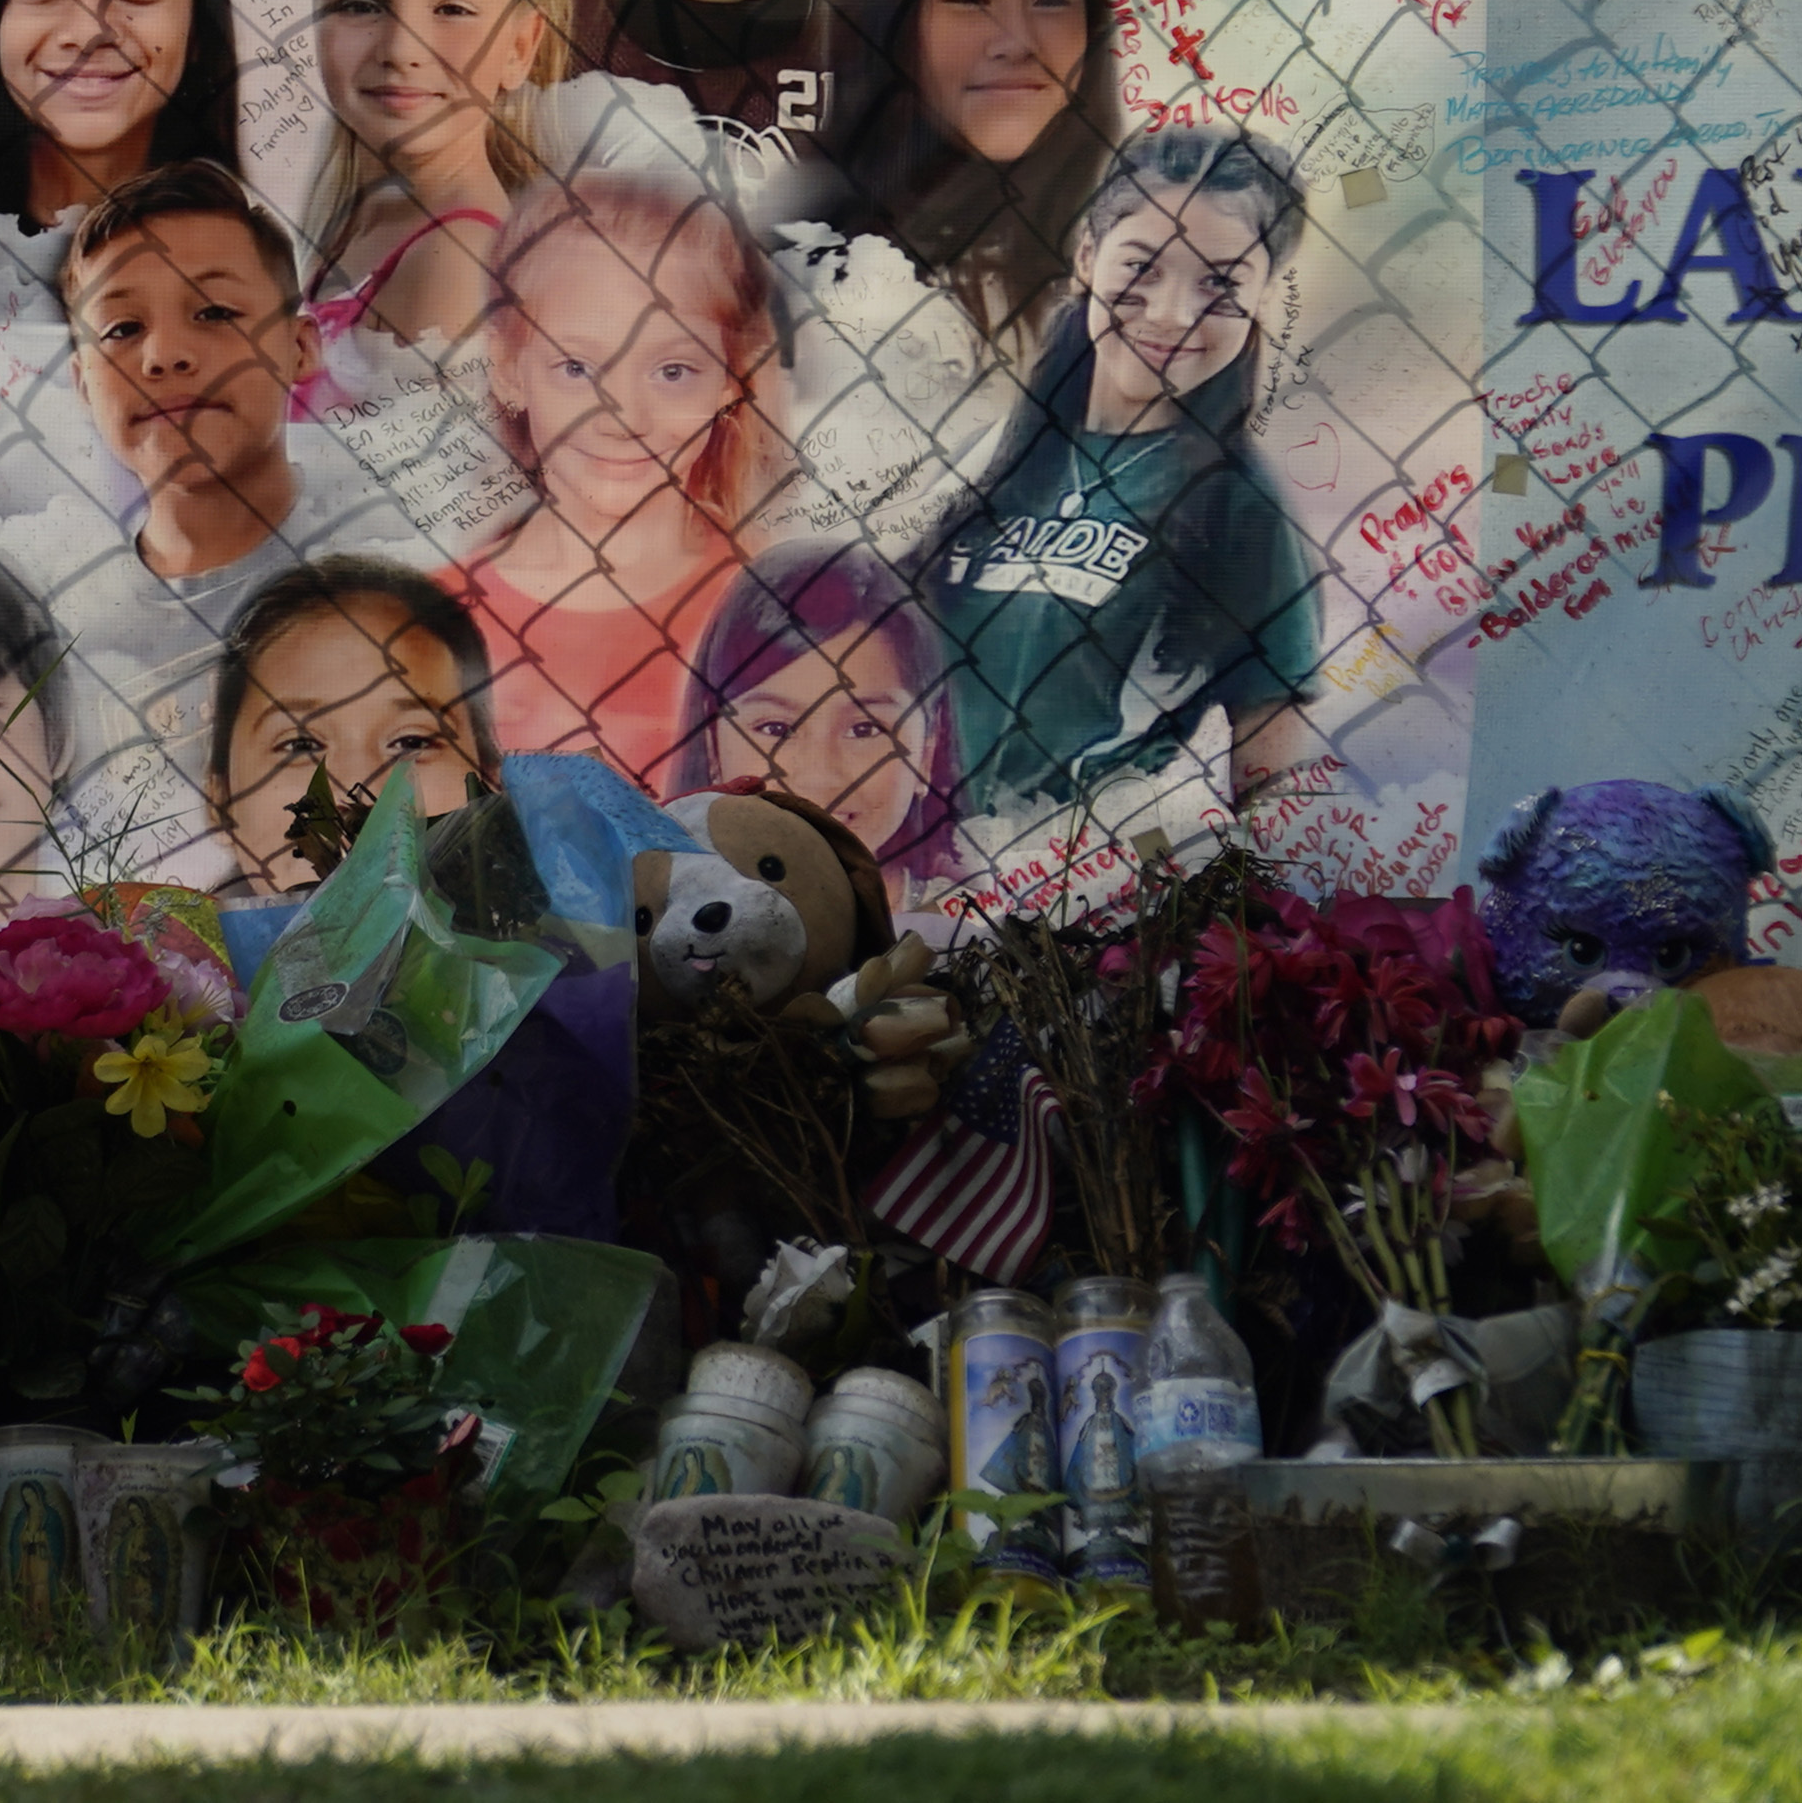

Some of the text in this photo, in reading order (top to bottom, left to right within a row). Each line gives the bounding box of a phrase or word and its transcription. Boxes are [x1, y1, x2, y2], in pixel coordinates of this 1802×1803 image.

[261, 4, 294, 29] In
[256, 34, 309, 68] Peace
[250, 112, 309, 161] Family
[1515, 167, 1802, 329] LA
[1543, 445, 1622, 486] Love
[1359, 463, 1475, 555] Prayers
[1638, 430, 1802, 590] P
[701, 1513, 809, 1540] May all
